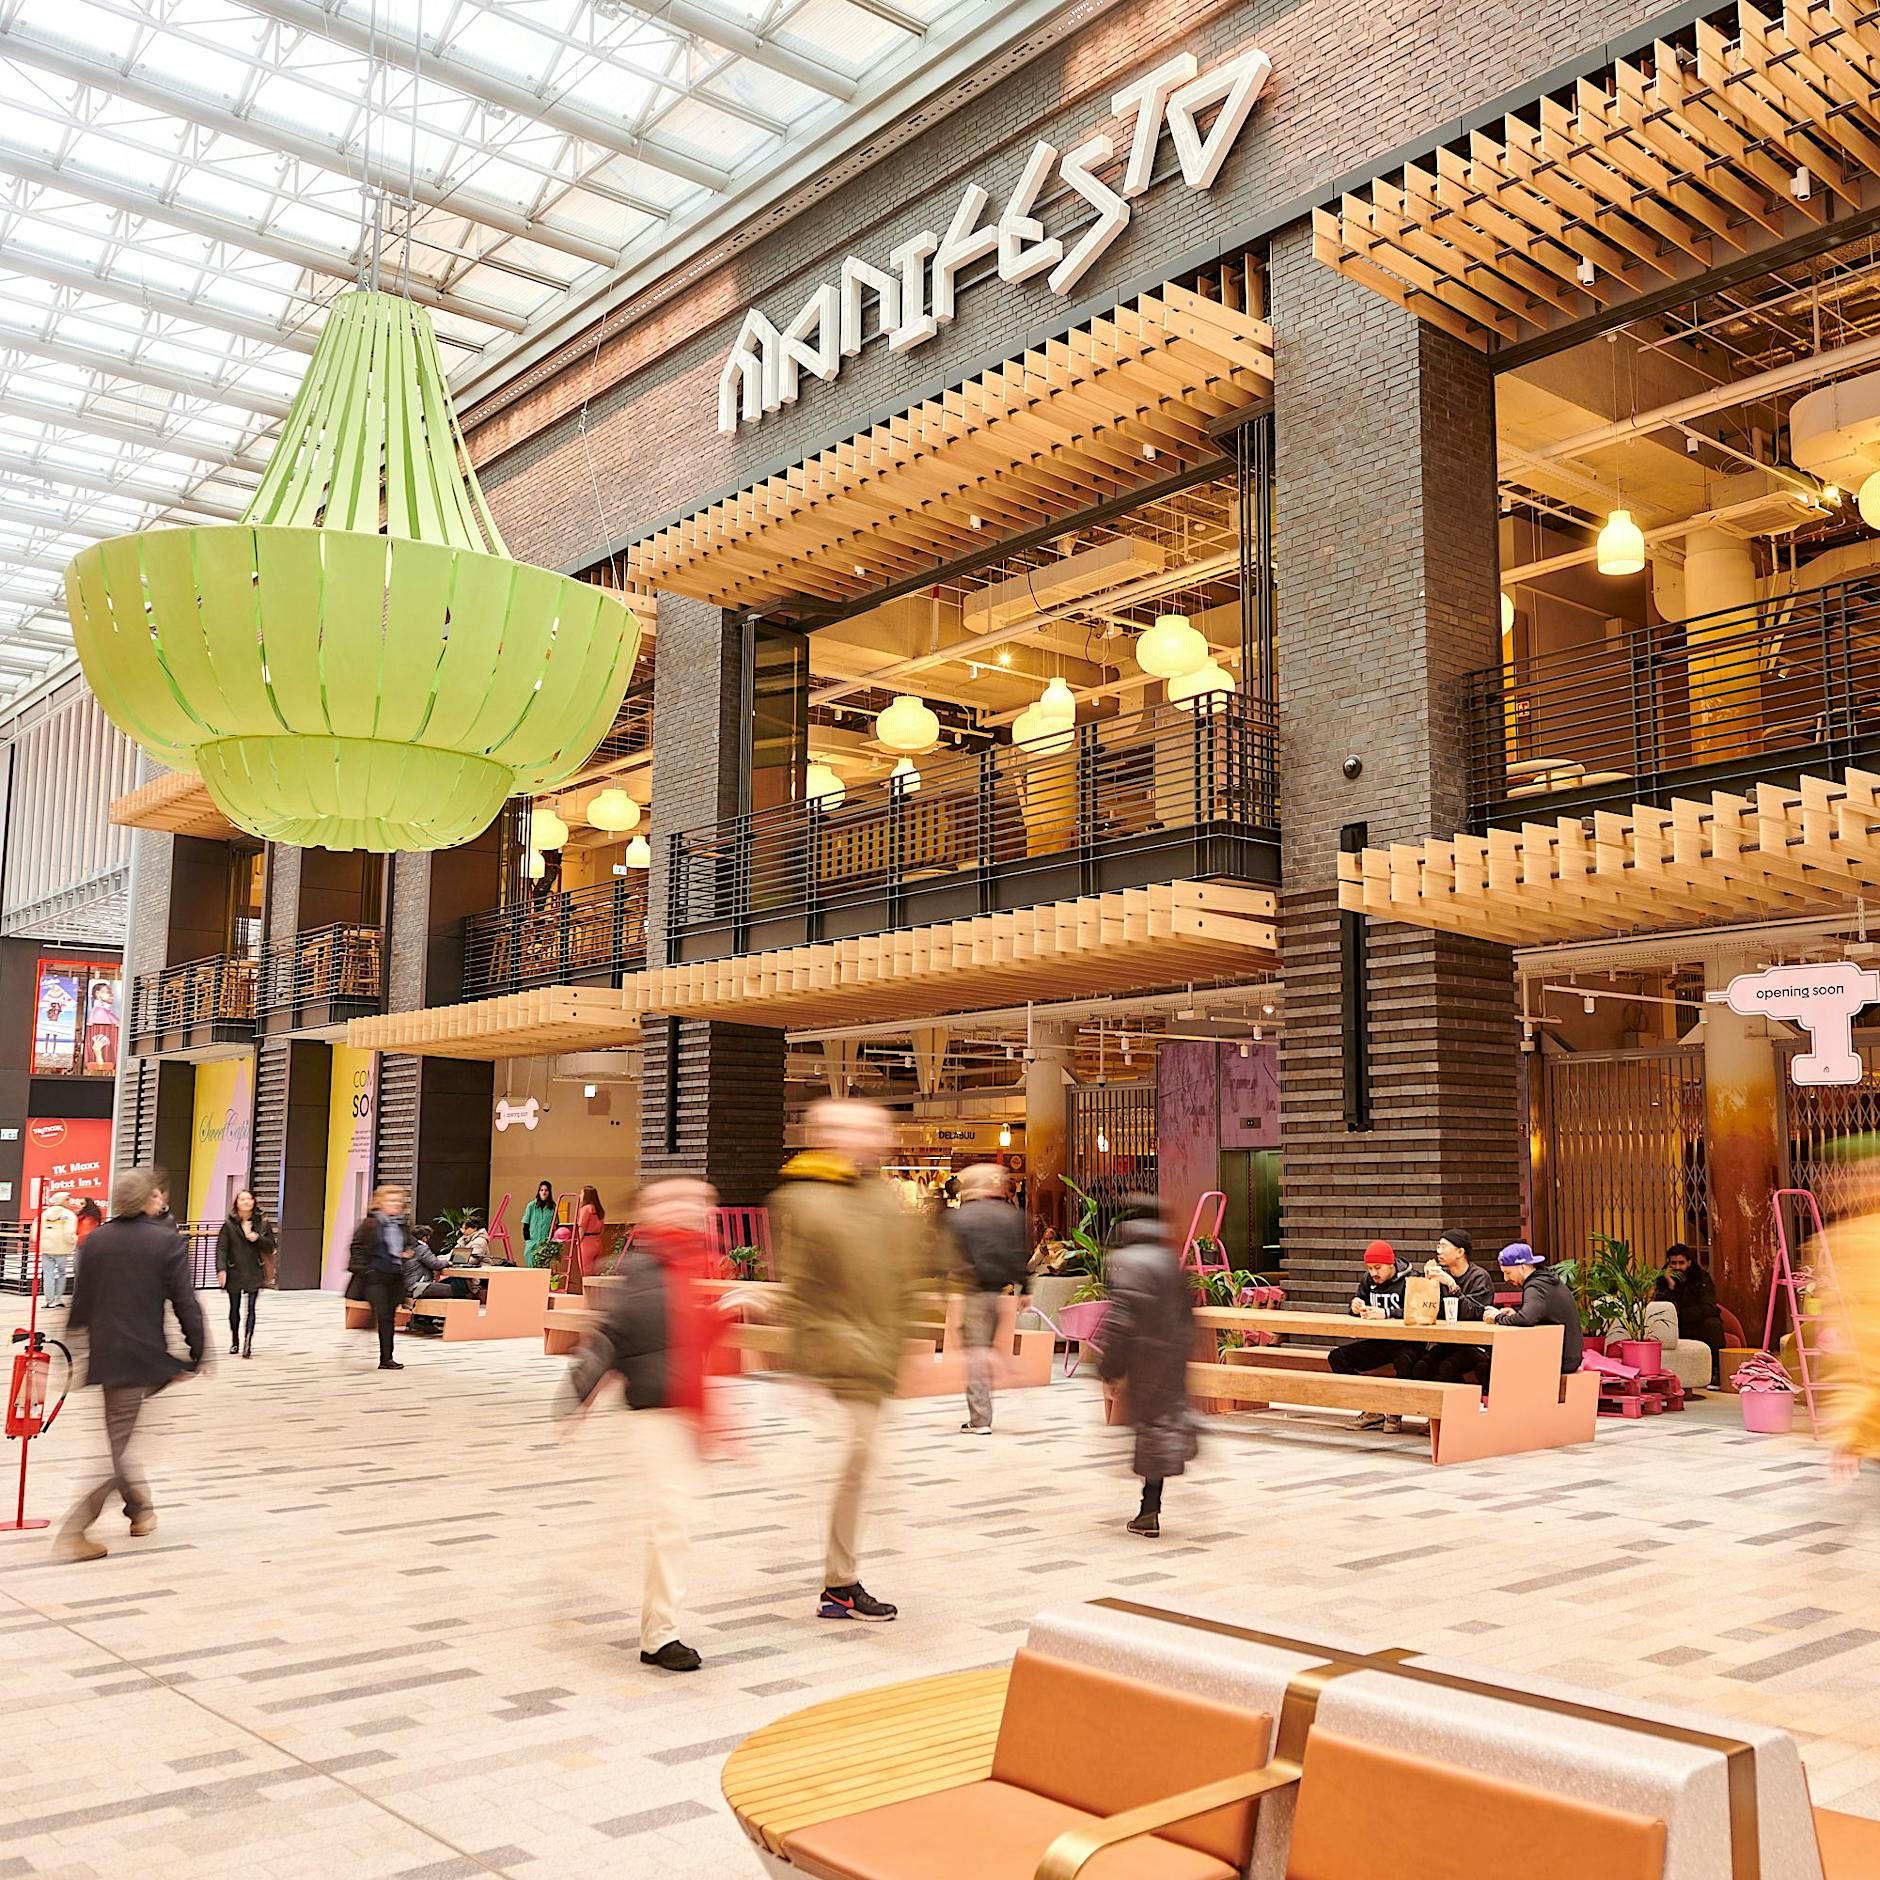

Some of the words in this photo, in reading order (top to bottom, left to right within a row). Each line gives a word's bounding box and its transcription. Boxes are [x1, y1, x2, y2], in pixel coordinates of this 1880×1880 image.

[718, 48, 1272, 435] MANIFESTO
[1756, 985, 1810, 1000] opening
[1812, 985, 1844, 996] soon
[352, 1093, 374, 1118] SO
[938, 1131, 975, 1140] DELABUU
[52, 1165, 66, 1175] TK
[70, 1162, 100, 1172] Maxx
[50, 1179, 75, 1191] jetzt
[1369, 1292, 1400, 1313] NETS
[1422, 1301, 1437, 1309] KFC
